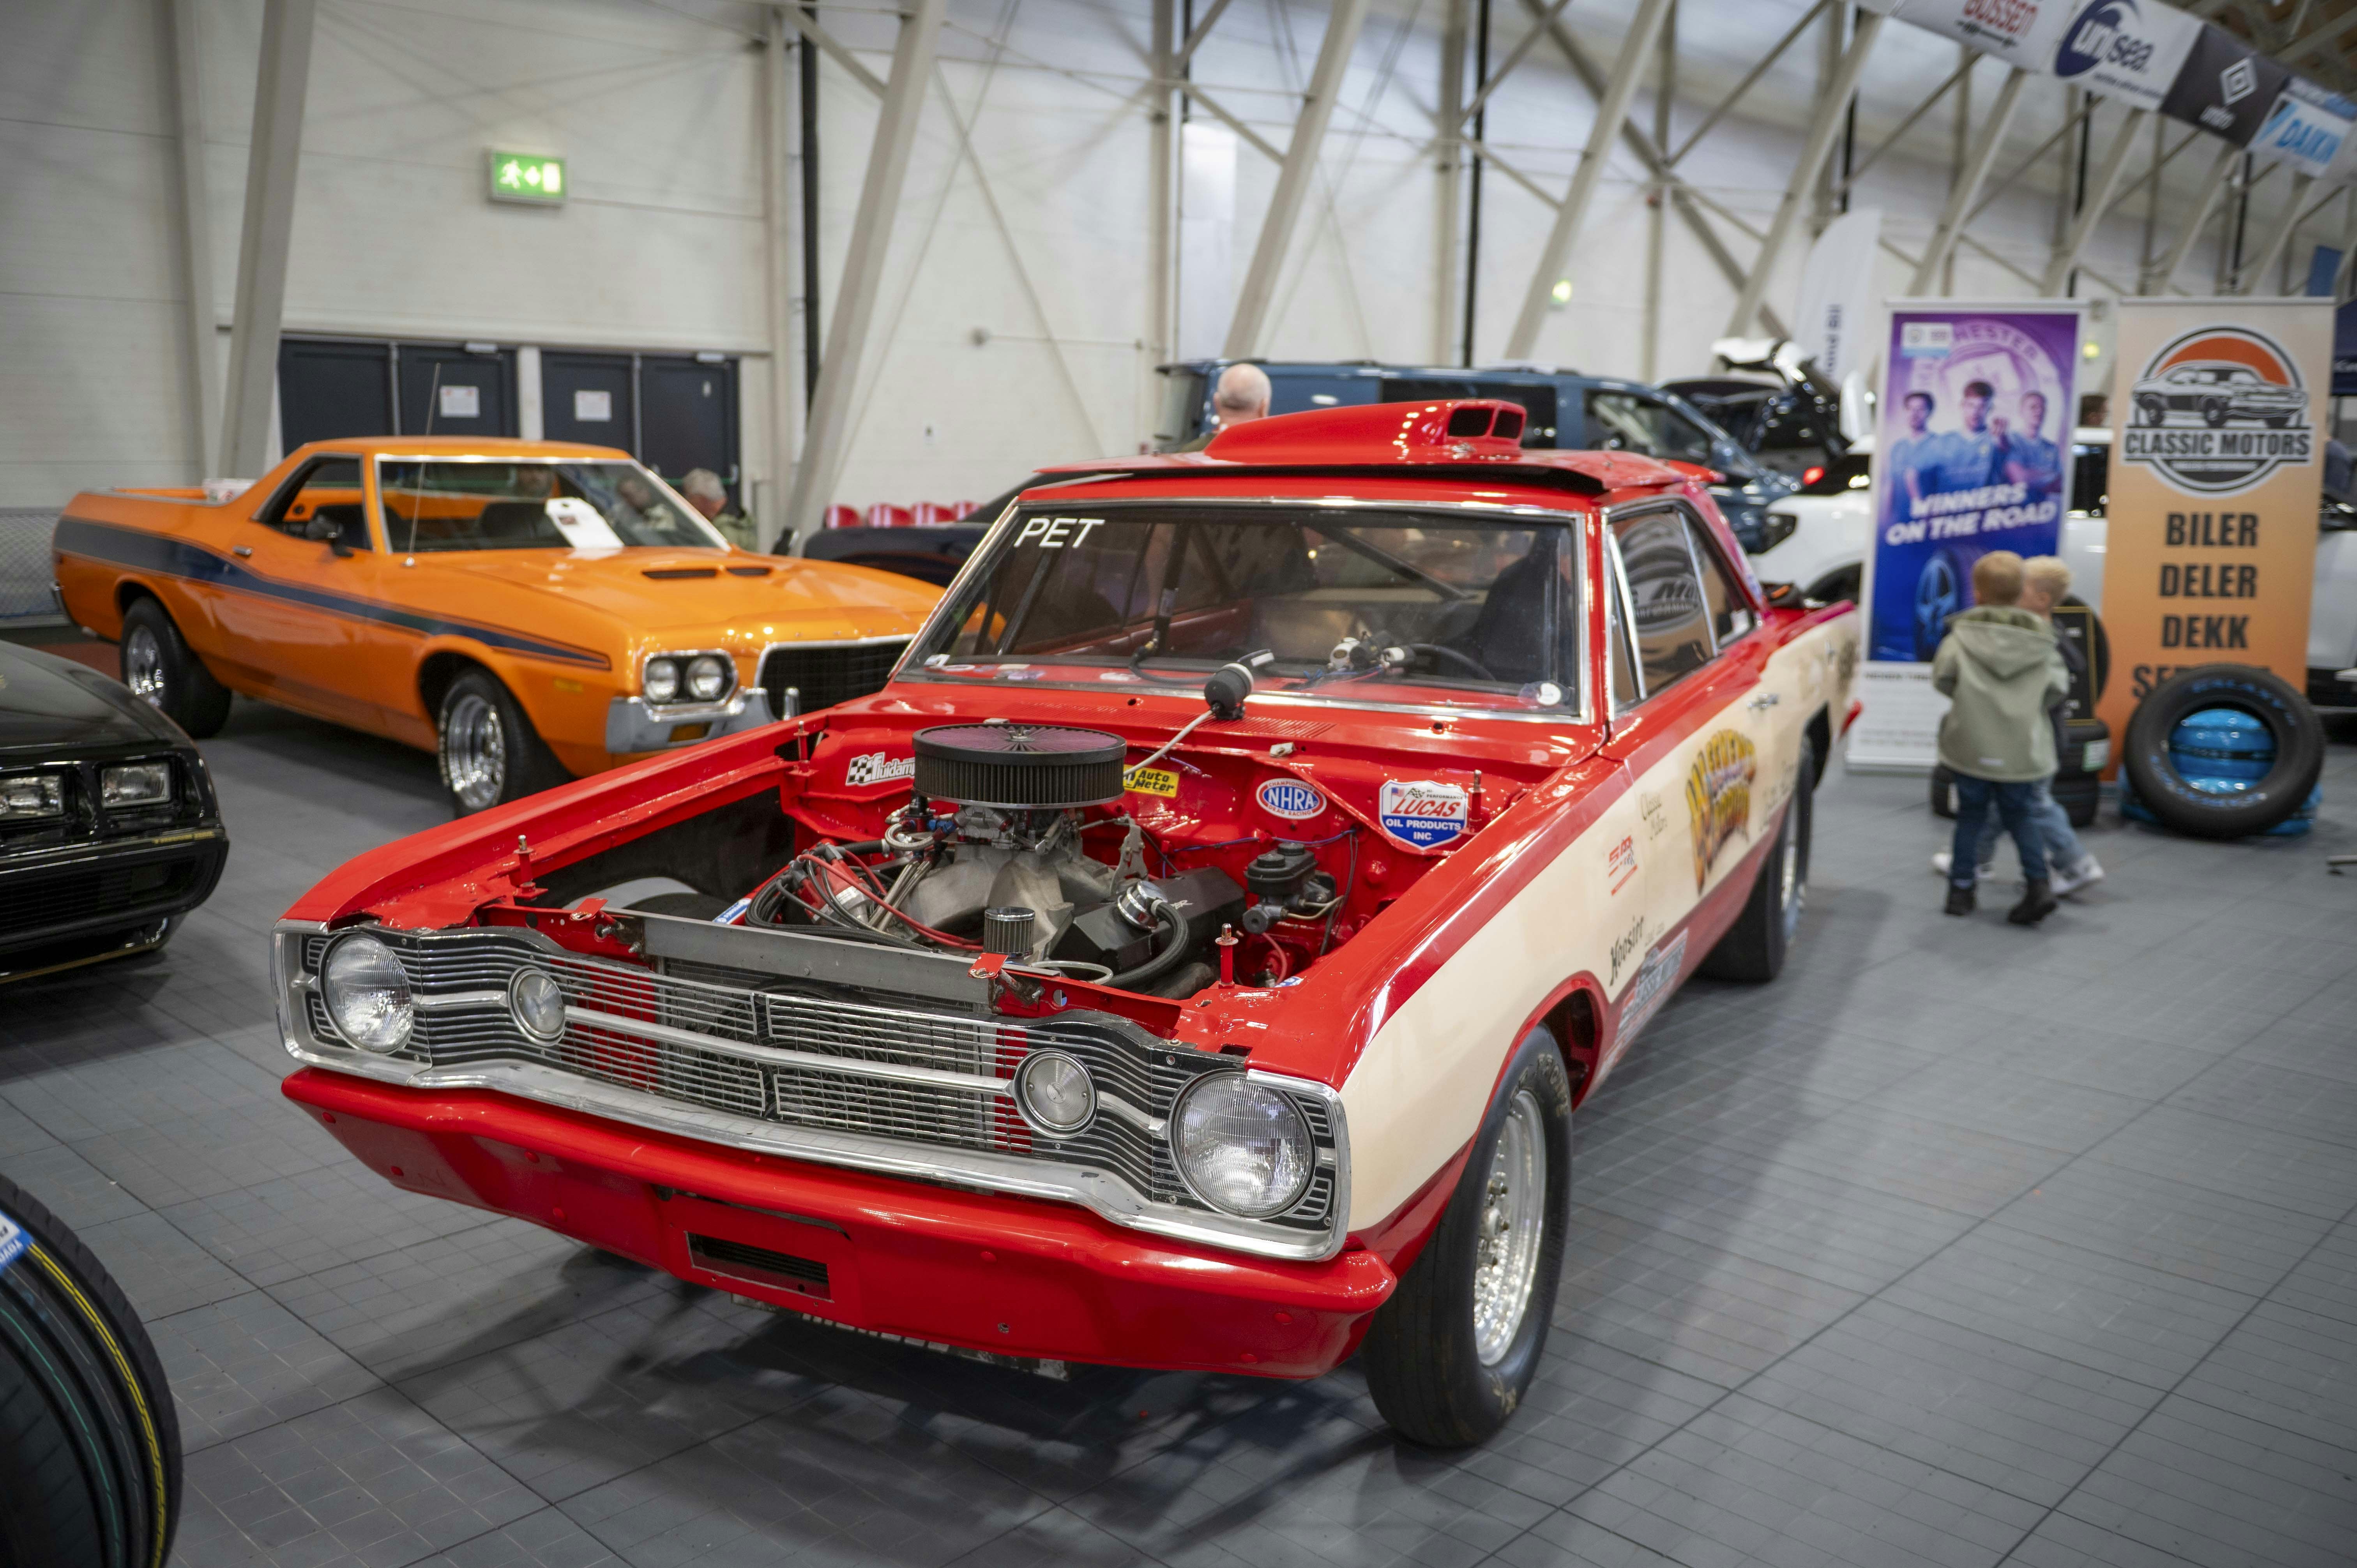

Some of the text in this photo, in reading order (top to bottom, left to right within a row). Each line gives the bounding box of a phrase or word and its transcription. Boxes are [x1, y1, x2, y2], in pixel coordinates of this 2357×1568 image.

[2125, 433, 2310, 456] CLASSIC MOTORS
[1911, 482, 2027, 518] WINNERS
[1014, 518, 1106, 548] PET
[1885, 501, 2057, 546] ON THE ROAD
[2166, 513, 2258, 546] BILER
[2159, 563, 2258, 597] DELER
[2161, 616, 2249, 648] DEKK
[1135, 779, 1174, 791] Meter
[1138, 770, 1170, 782] Auto
[1269, 781, 1313, 791] CHAMPIONSHIP
[1269, 787, 1315, 810] NHRA
[1269, 805, 1285, 814] DRAG
[1391, 799, 1461, 817] LUCAS
[1386, 818, 1461, 831] OIL PRODUCTS
